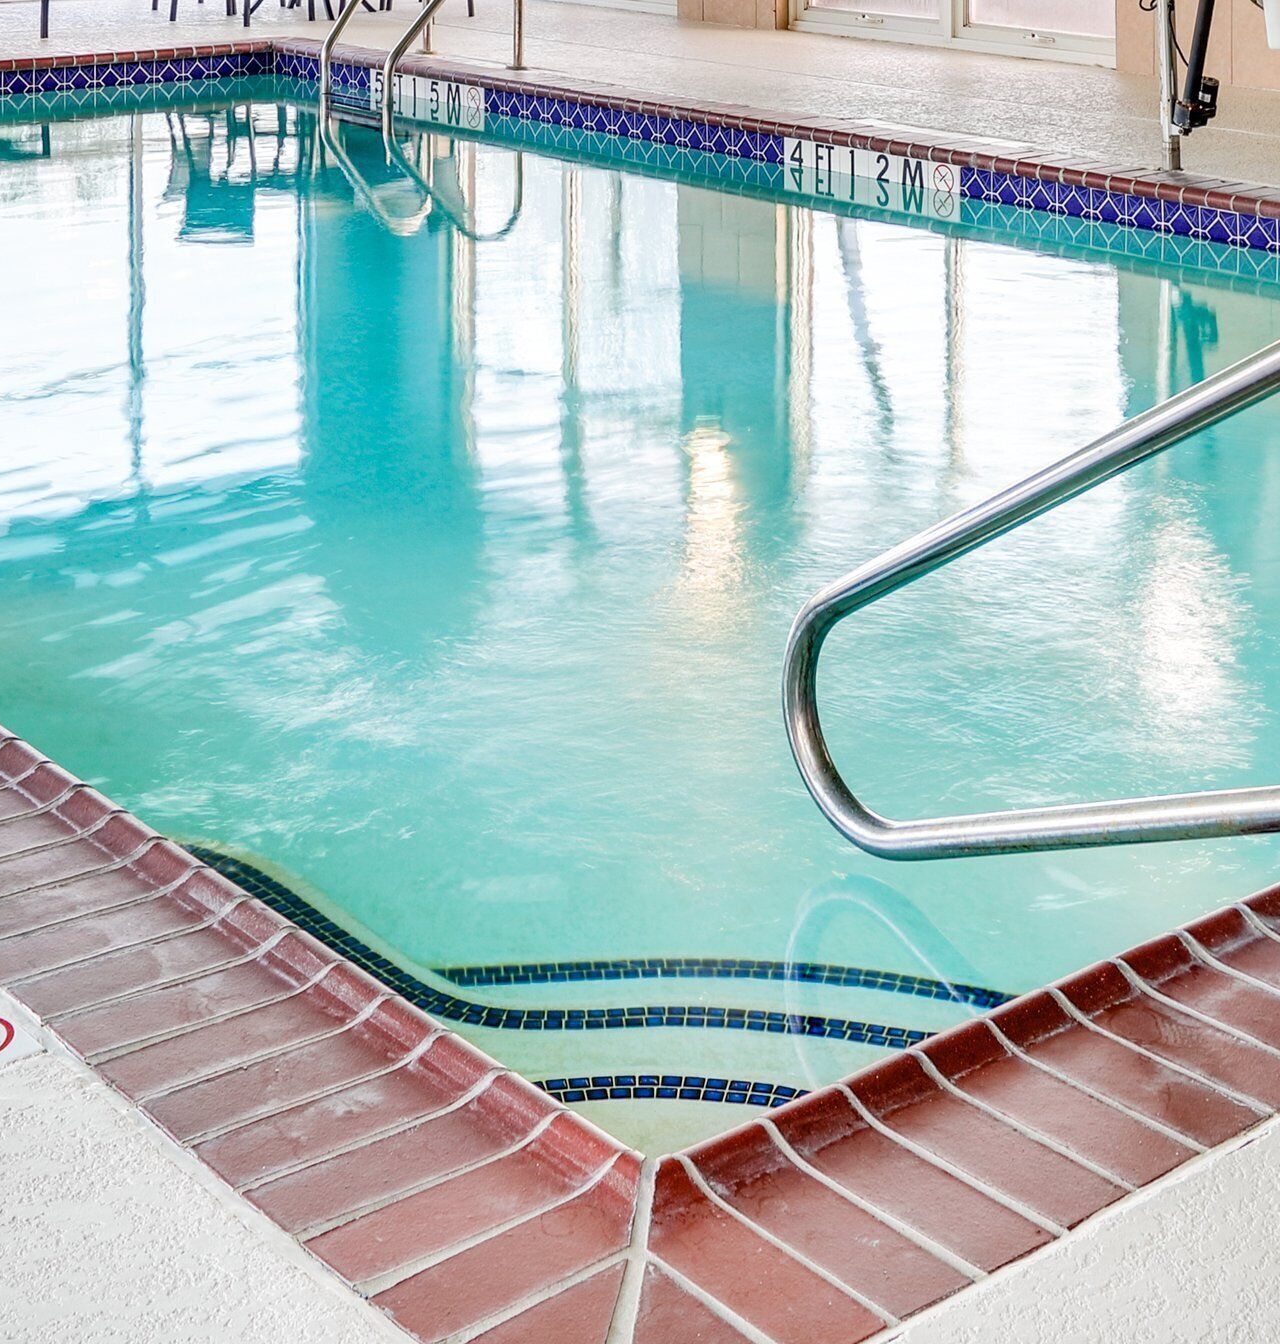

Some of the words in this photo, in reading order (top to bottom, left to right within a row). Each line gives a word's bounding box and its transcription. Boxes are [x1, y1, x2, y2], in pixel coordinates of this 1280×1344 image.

[447, 83, 461, 105] M
[790, 140, 803, 167] 4
[816, 144, 834, 172] FT
[902, 158, 924, 188] M
